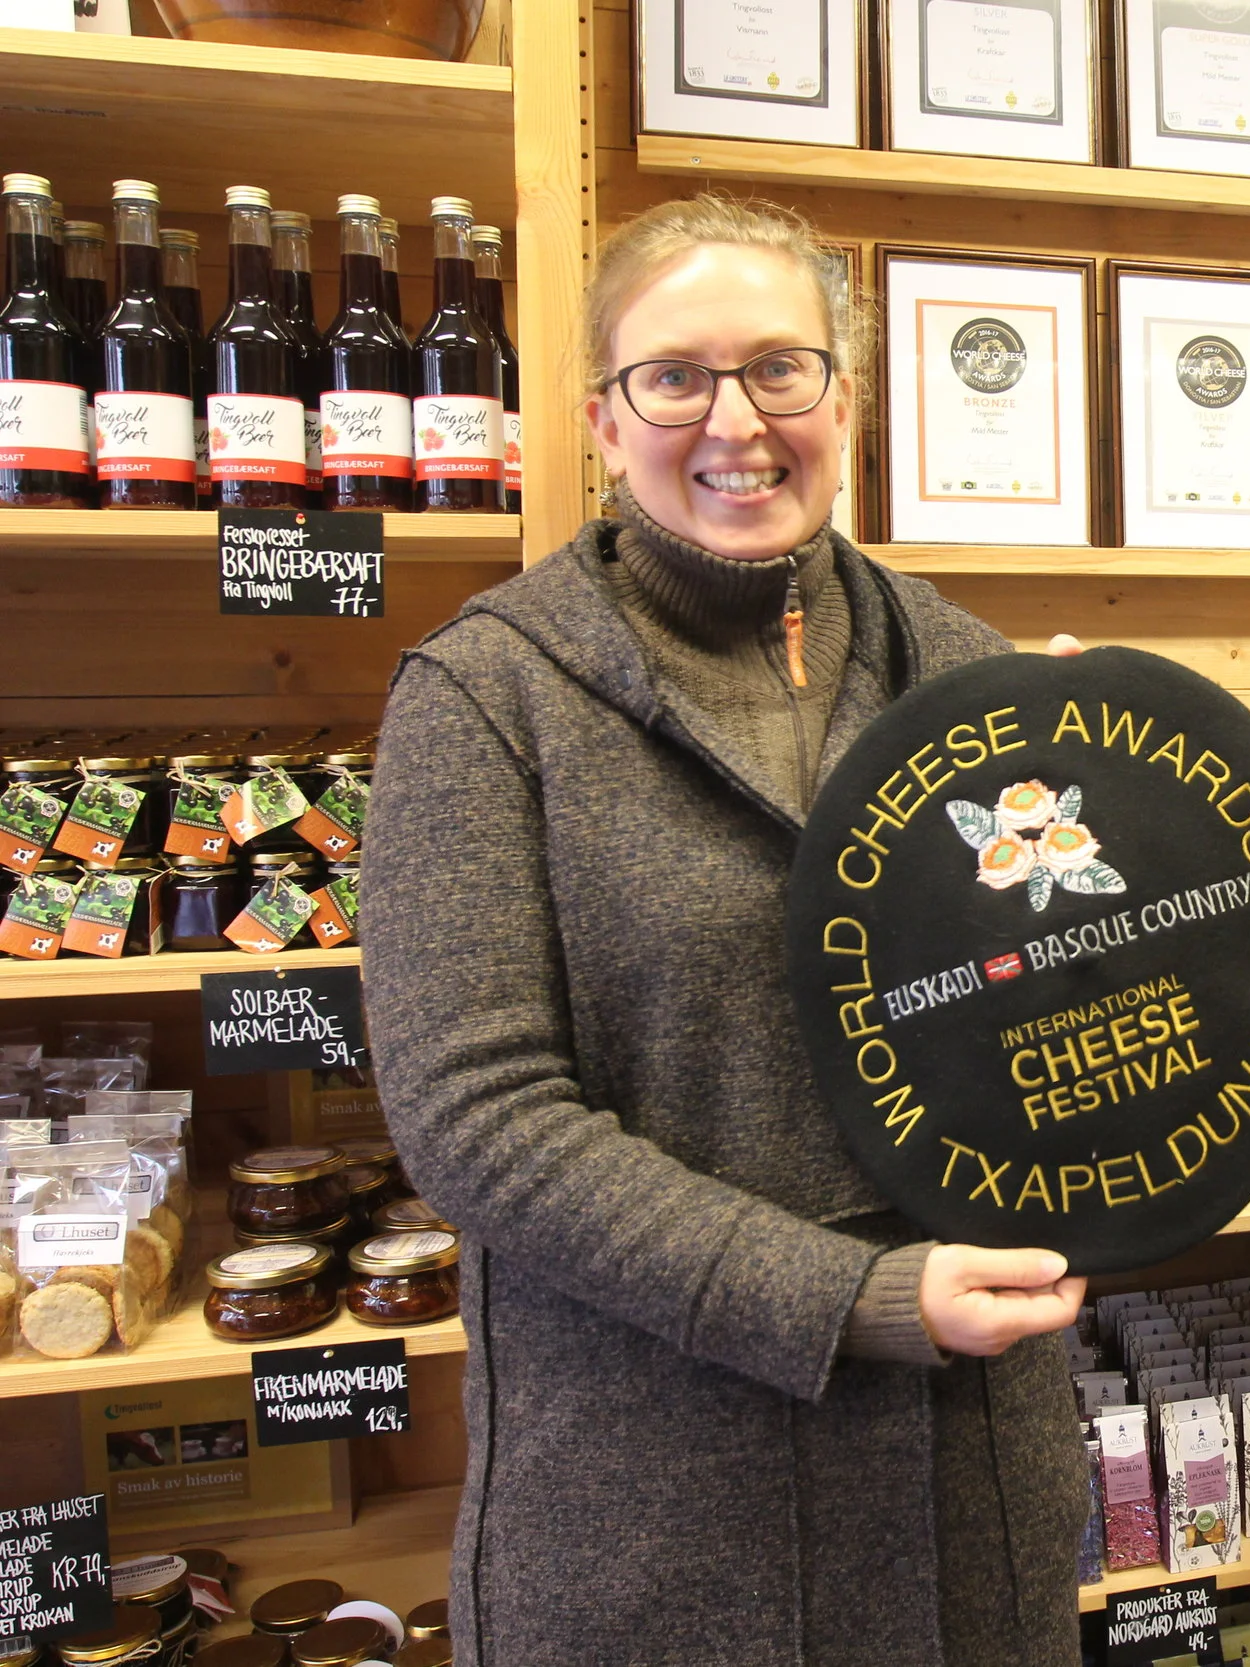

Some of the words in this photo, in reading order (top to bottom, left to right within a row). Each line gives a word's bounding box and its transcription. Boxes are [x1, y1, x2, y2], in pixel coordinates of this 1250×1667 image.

[732, 2, 773, 14] Tingvollost
[973, 7, 1008, 19] SILVER
[952, 349, 991, 361] WORLD
[991, 351, 1025, 362] CHEESE
[971, 371, 1006, 383] AWARDS
[1178, 366, 1214, 377] WORLD
[1214, 367, 1246, 379] CHEESE
[963, 397, 1017, 409] BRONZE
[1195, 386, 1228, 398] AWARDS
[96, 401, 149, 429] Tingvoll
[214, 401, 276, 431] Tingvoll
[325, 399, 383, 427] Tingvoll
[428, 403, 488, 431] Tingvoll
[424, 464, 490, 474] BRINGEBÆRSAFT
[223, 525, 311, 551] Ferskpresset
[221, 546, 384, 584] BRINGEBÆRSAFT
[241, 581, 293, 609] Tingvoll
[836, 705, 1028, 890] CHEESE
[883, 960, 984, 1022] EUSKADI
[1025, 911, 1139, 973] BASQUE
[1000, 972, 1185, 1049] INTERNATIONAL
[209, 1015, 344, 1048] MARMELADE
[823, 915, 926, 1147] WORLD
[1010, 991, 1200, 1090] CHEESE
[1022, 1039, 1213, 1132] FESTIVAL
[320, 1101, 362, 1116] Smak
[61, 1225, 111, 1238] Lhuset
[254, 1363, 408, 1402] FIKENMARMELADE
[267, 1398, 352, 1423] M/KONJAKK
[1110, 1436, 1138, 1447] AUKRUST
[1189, 1440, 1217, 1451] AUKRUST
[118, 1478, 161, 1495] Smak
[164, 1479, 182, 1490] av
[186, 1469, 243, 1487] historie
[1109, 1463, 1143, 1476] KORNBLOM
[1189, 1467, 1223, 1482] EPLEKNASK
[21, 1505, 48, 1527] FRA
[50, 1493, 105, 1522] LHUSET
[52, 1555, 79, 1591] KR
[20, 1602, 74, 1632] KROKAN
[1116, 1591, 1183, 1621] PRODUKTER
[1186, 1588, 1210, 1607] FRA
[1175, 1606, 1218, 1634] AUKRUST
